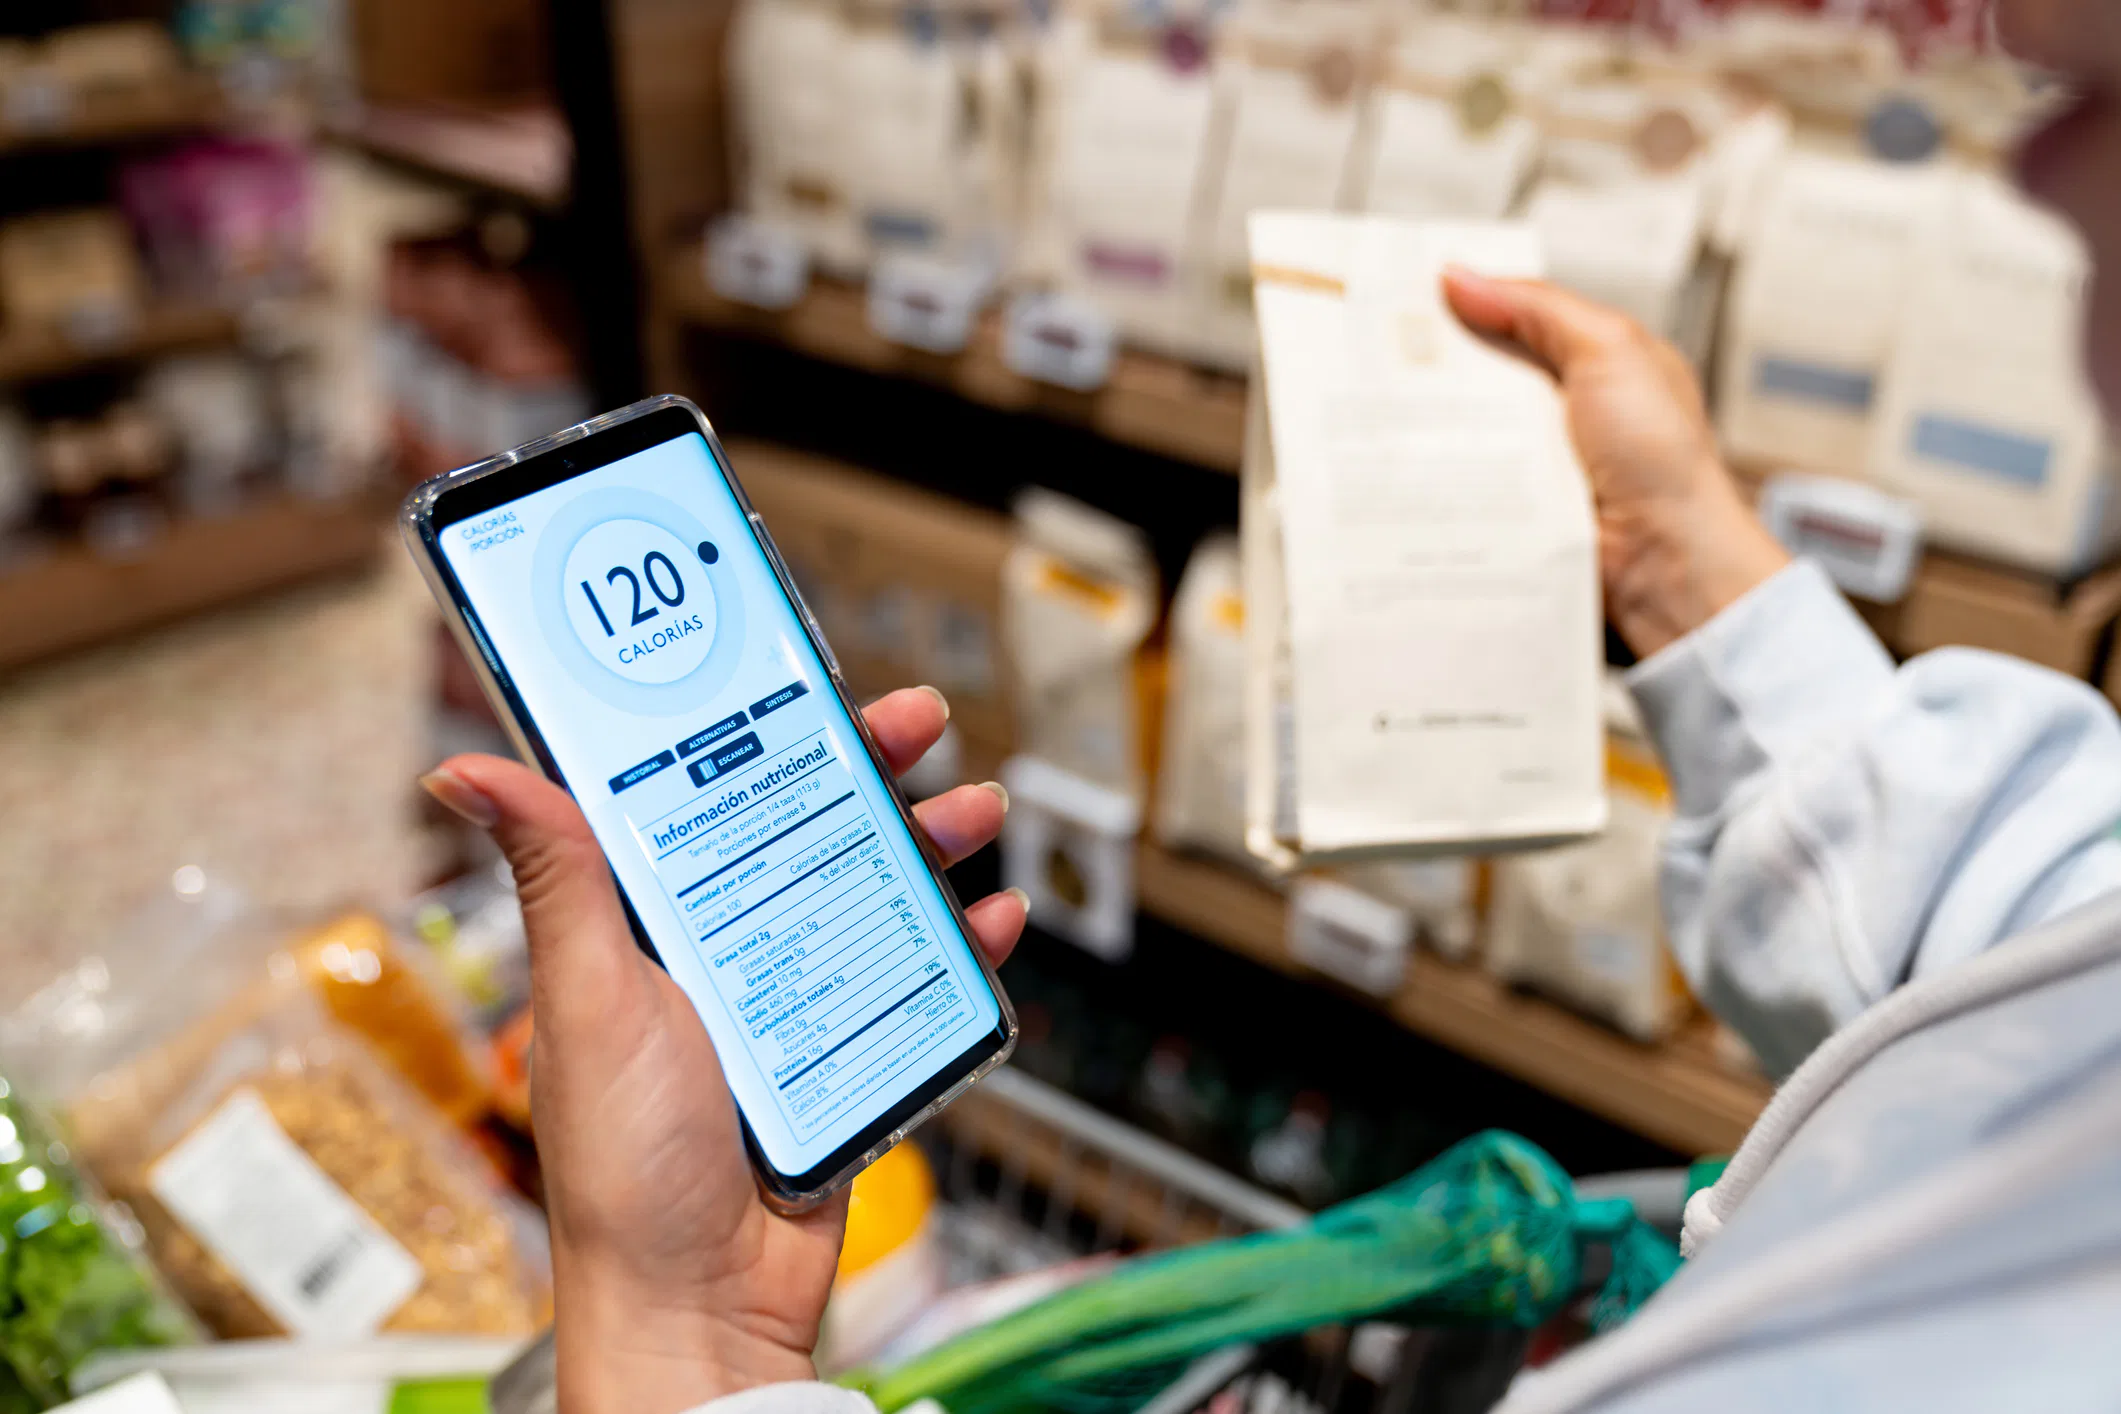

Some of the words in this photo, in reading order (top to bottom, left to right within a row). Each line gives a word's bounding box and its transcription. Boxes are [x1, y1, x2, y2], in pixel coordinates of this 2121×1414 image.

[580, 551, 685, 637] 120
[619, 615, 703, 664] CALORÍAS
[765, 690, 793, 709] SINTESIS
[689, 720, 736, 749] ALTERNATIVAS
[718, 743, 754, 766] ESCANEAR
[623, 761, 661, 783] HISTORIAL
[653, 790, 749, 849] Información
[751, 741, 828, 796] nutricional
[688, 839, 719, 857] Tamaño
[720, 832, 730, 841] de
[739, 811, 767, 832] porción
[767, 802, 780, 813] 1/4
[780, 794, 796, 807] taza
[795, 783, 812, 799] (113
[812, 778, 821, 790] g)
[717, 832, 757, 858] Porciones
[757, 823, 771, 838] por
[773, 807, 800, 827] envase
[799, 801, 807, 811] 8
[819, 848, 829, 857] de
[828, 841, 840, 850] las
[840, 828, 862, 846] grasas
[861, 819, 872, 831] 20
[819, 872, 829, 881] %
[829, 864, 841, 877] del
[840, 855, 858, 869] valor
[872, 857, 885, 869] 3%
[879, 872, 893, 884] 7%
[685, 886, 722, 912] Cantidad
[722, 878, 736, 892] por
[738, 861, 767, 883] porción
[726, 899, 742, 912] 100
[890, 898, 907, 911] 19%
[900, 911, 913, 922] 3%
[907, 923, 919, 934] 1%
[913, 936, 926, 948] 7%
[714, 951, 739, 968] Grasa
[738, 936, 758, 953] total
[758, 931, 771, 941] 2g
[739, 955, 766, 974] Grasas
[766, 932, 804, 957] saturadas
[800, 920, 819, 935] 1.5g
[746, 968, 774, 987] Grasas
[773, 954, 794, 970] trans
[794, 947, 806, 957] 0g
[924, 961, 940, 975] 19%
[737, 981, 778, 1011] Colesterol
[778, 974, 789, 984] 10
[789, 967, 803, 978] mg
[904, 993, 934, 1015] Vitamina
[933, 986, 941, 995] C
[939, 979, 952, 990] 0%
[745, 1008, 768, 1026] Sodio
[769, 995, 783, 1009] 460
[783, 988, 799, 1000] mg
[752, 1000, 807, 1039] Carbohidratos
[807, 982, 834, 1003] totales
[834, 974, 846, 987] 4g
[925, 1001, 947, 1019] Hierro
[946, 992, 958, 1004] 0%
[775, 1026, 796, 1041] Fibra
[795, 1018, 808, 1029] 0g
[783, 1030, 816, 1056] Azúcares
[816, 1023, 828, 1033] 4g
[774, 1055, 807, 1080] Proteína
[807, 1045, 823, 1057] 16g
[887, 1057, 901, 1069] basan
[908, 1046, 917, 1054] una
[917, 1037, 929, 1048] dieta
[784, 1076, 818, 1101] Vitamina
[818, 1070, 825, 1078] A
[824, 1060, 838, 1073] 0%
[792, 1096, 816, 1115] Calcio
[815, 1086, 829, 1098] 8%
